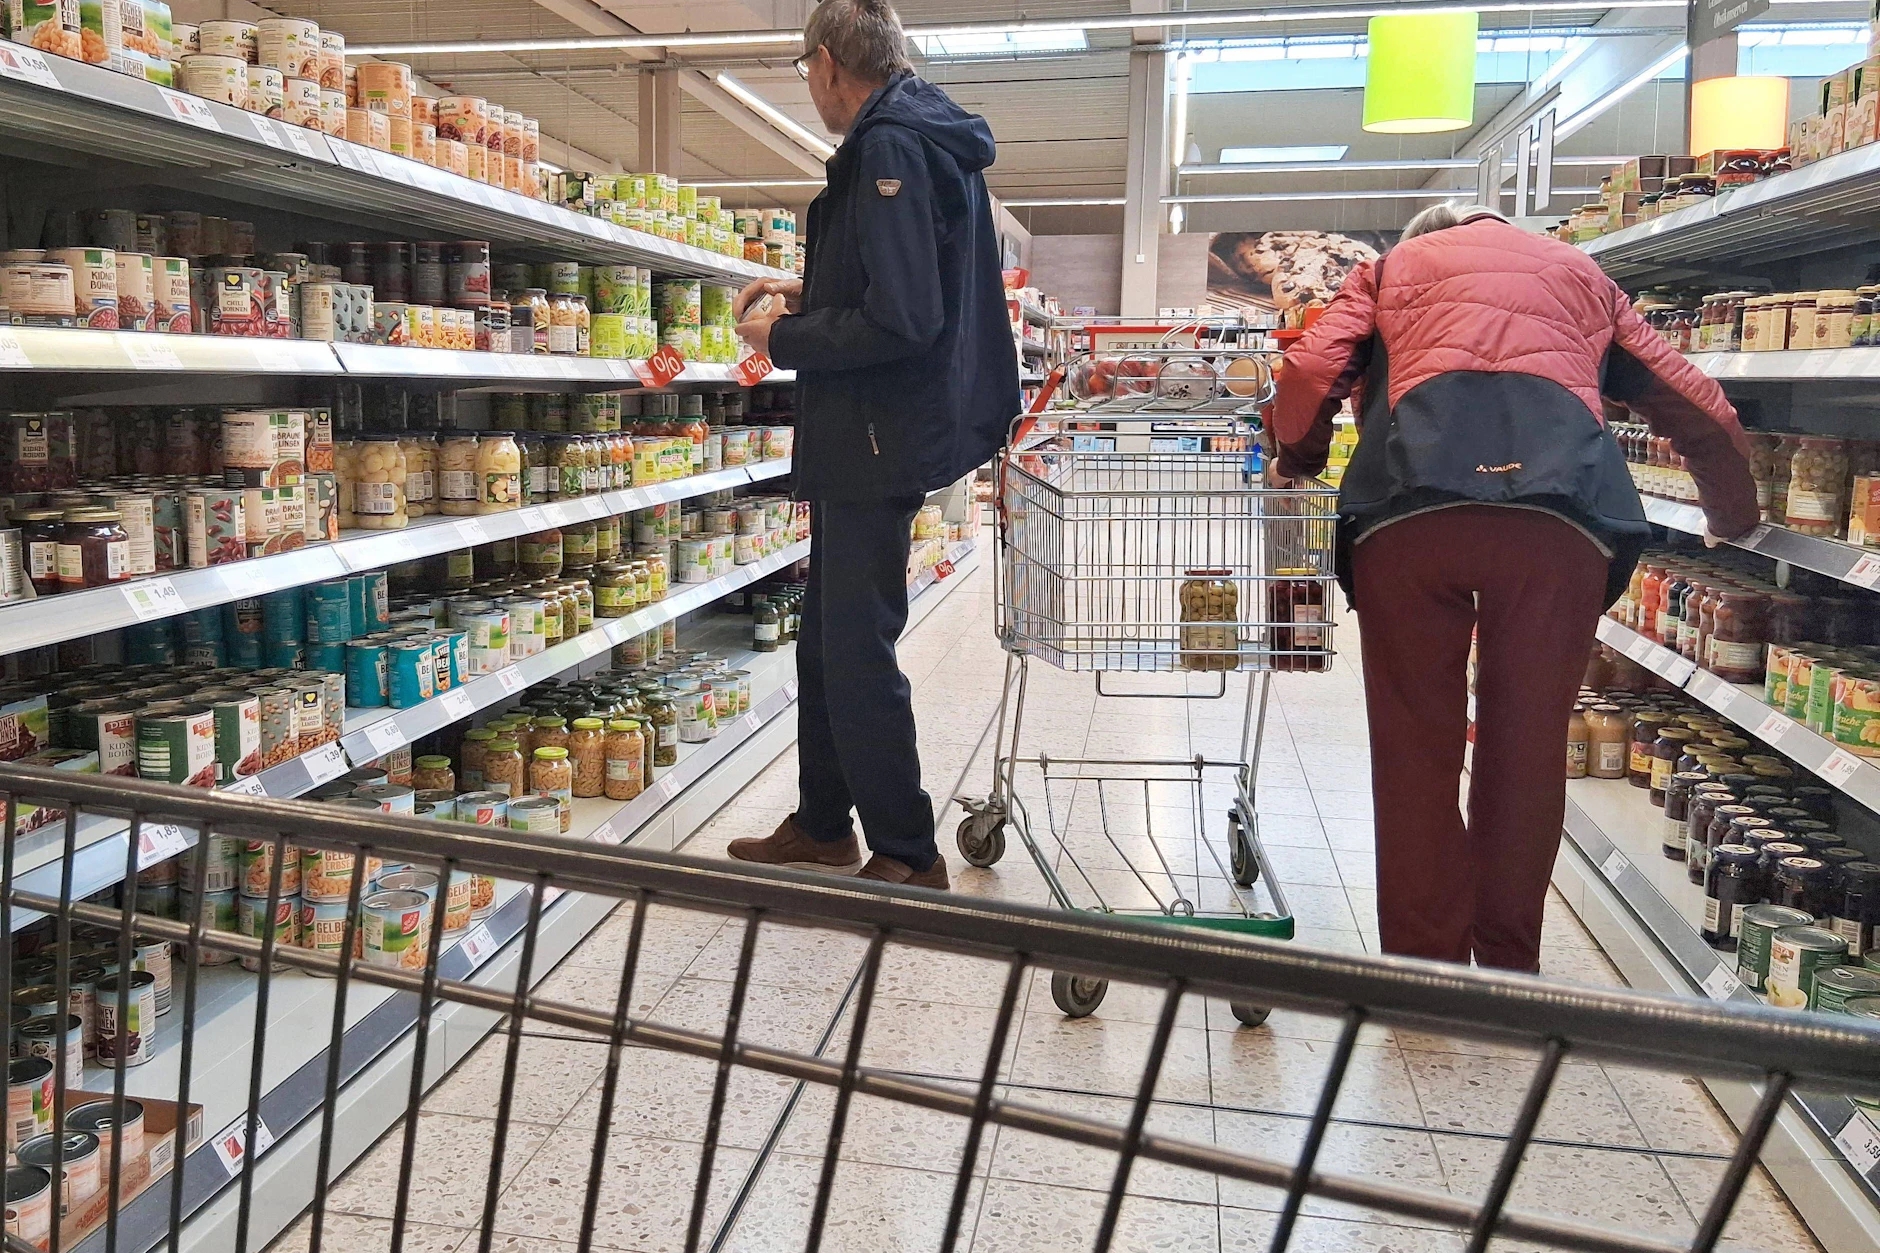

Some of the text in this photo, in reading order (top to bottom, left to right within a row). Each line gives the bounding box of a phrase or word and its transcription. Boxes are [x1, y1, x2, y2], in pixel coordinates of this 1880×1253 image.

[21, 56, 48, 72] 0,59
[1489, 463, 1522, 472] VAUDE
[154, 586, 176, 600] 1,49
[324, 749, 340, 762] 1,39
[245, 783, 262, 795] 159
[325, 860, 355, 871] ERBSE
[1863, 1138, 1880, 1160] 3,59
